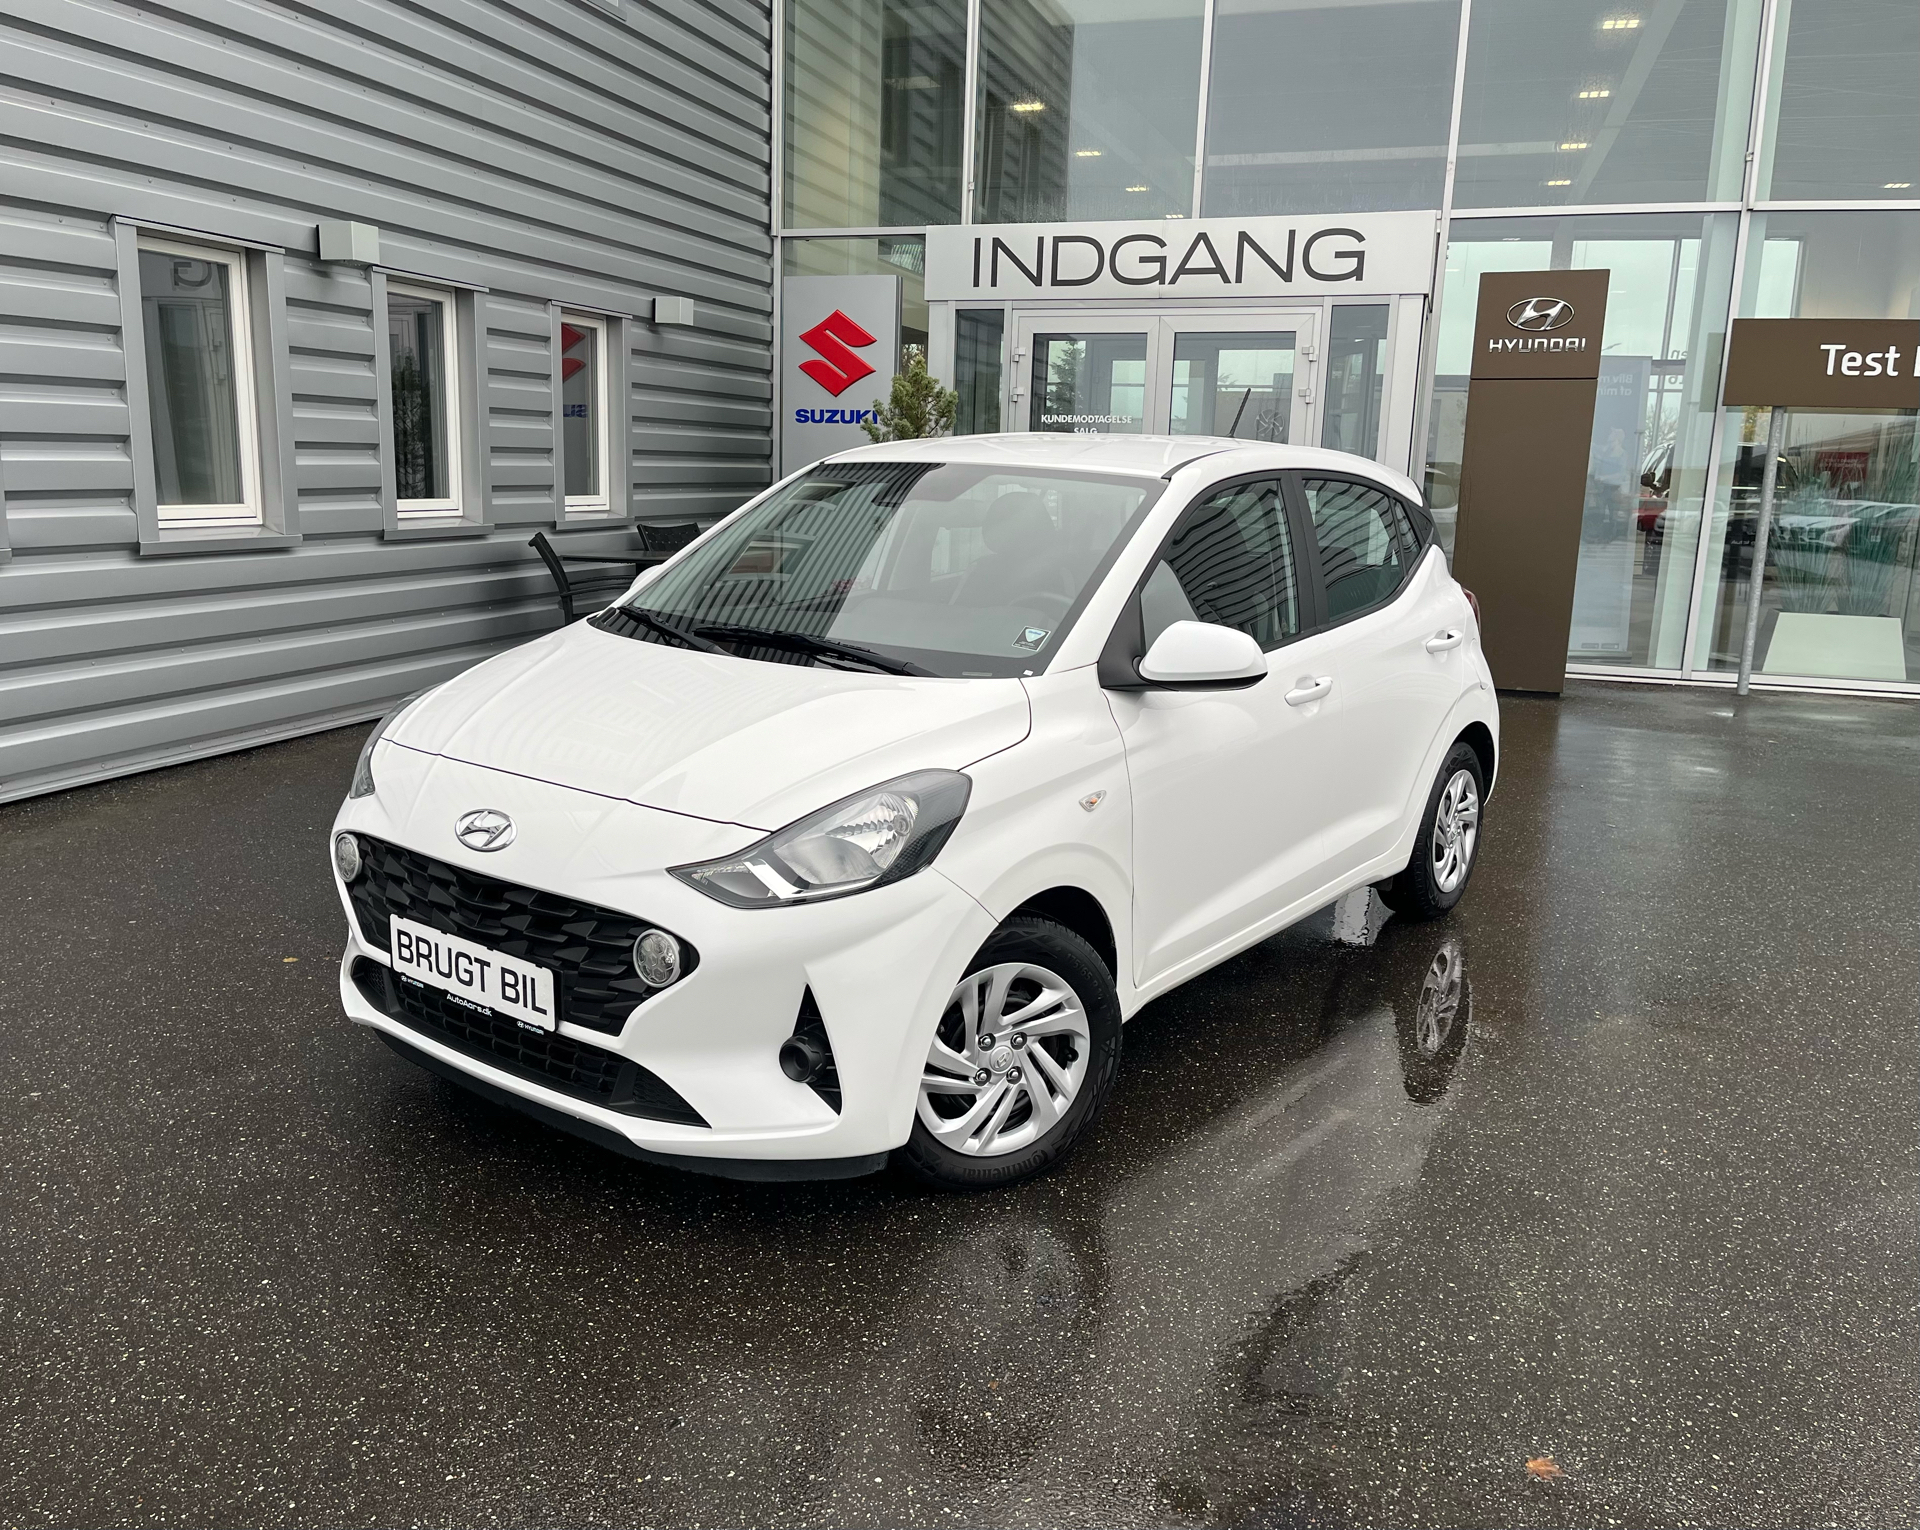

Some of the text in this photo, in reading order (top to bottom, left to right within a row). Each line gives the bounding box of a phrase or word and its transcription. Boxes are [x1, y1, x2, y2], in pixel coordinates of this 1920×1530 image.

[972, 228, 1366, 287] INDGANG
[1489, 338, 1586, 353] HYUNDAI
[1820, 344, 1901, 377] Test
[795, 409, 878, 424] SUZUKI
[1041, 414, 1132, 424] KUNDEMODTAGELSE
[397, 928, 548, 1016] BRUGT BIL
